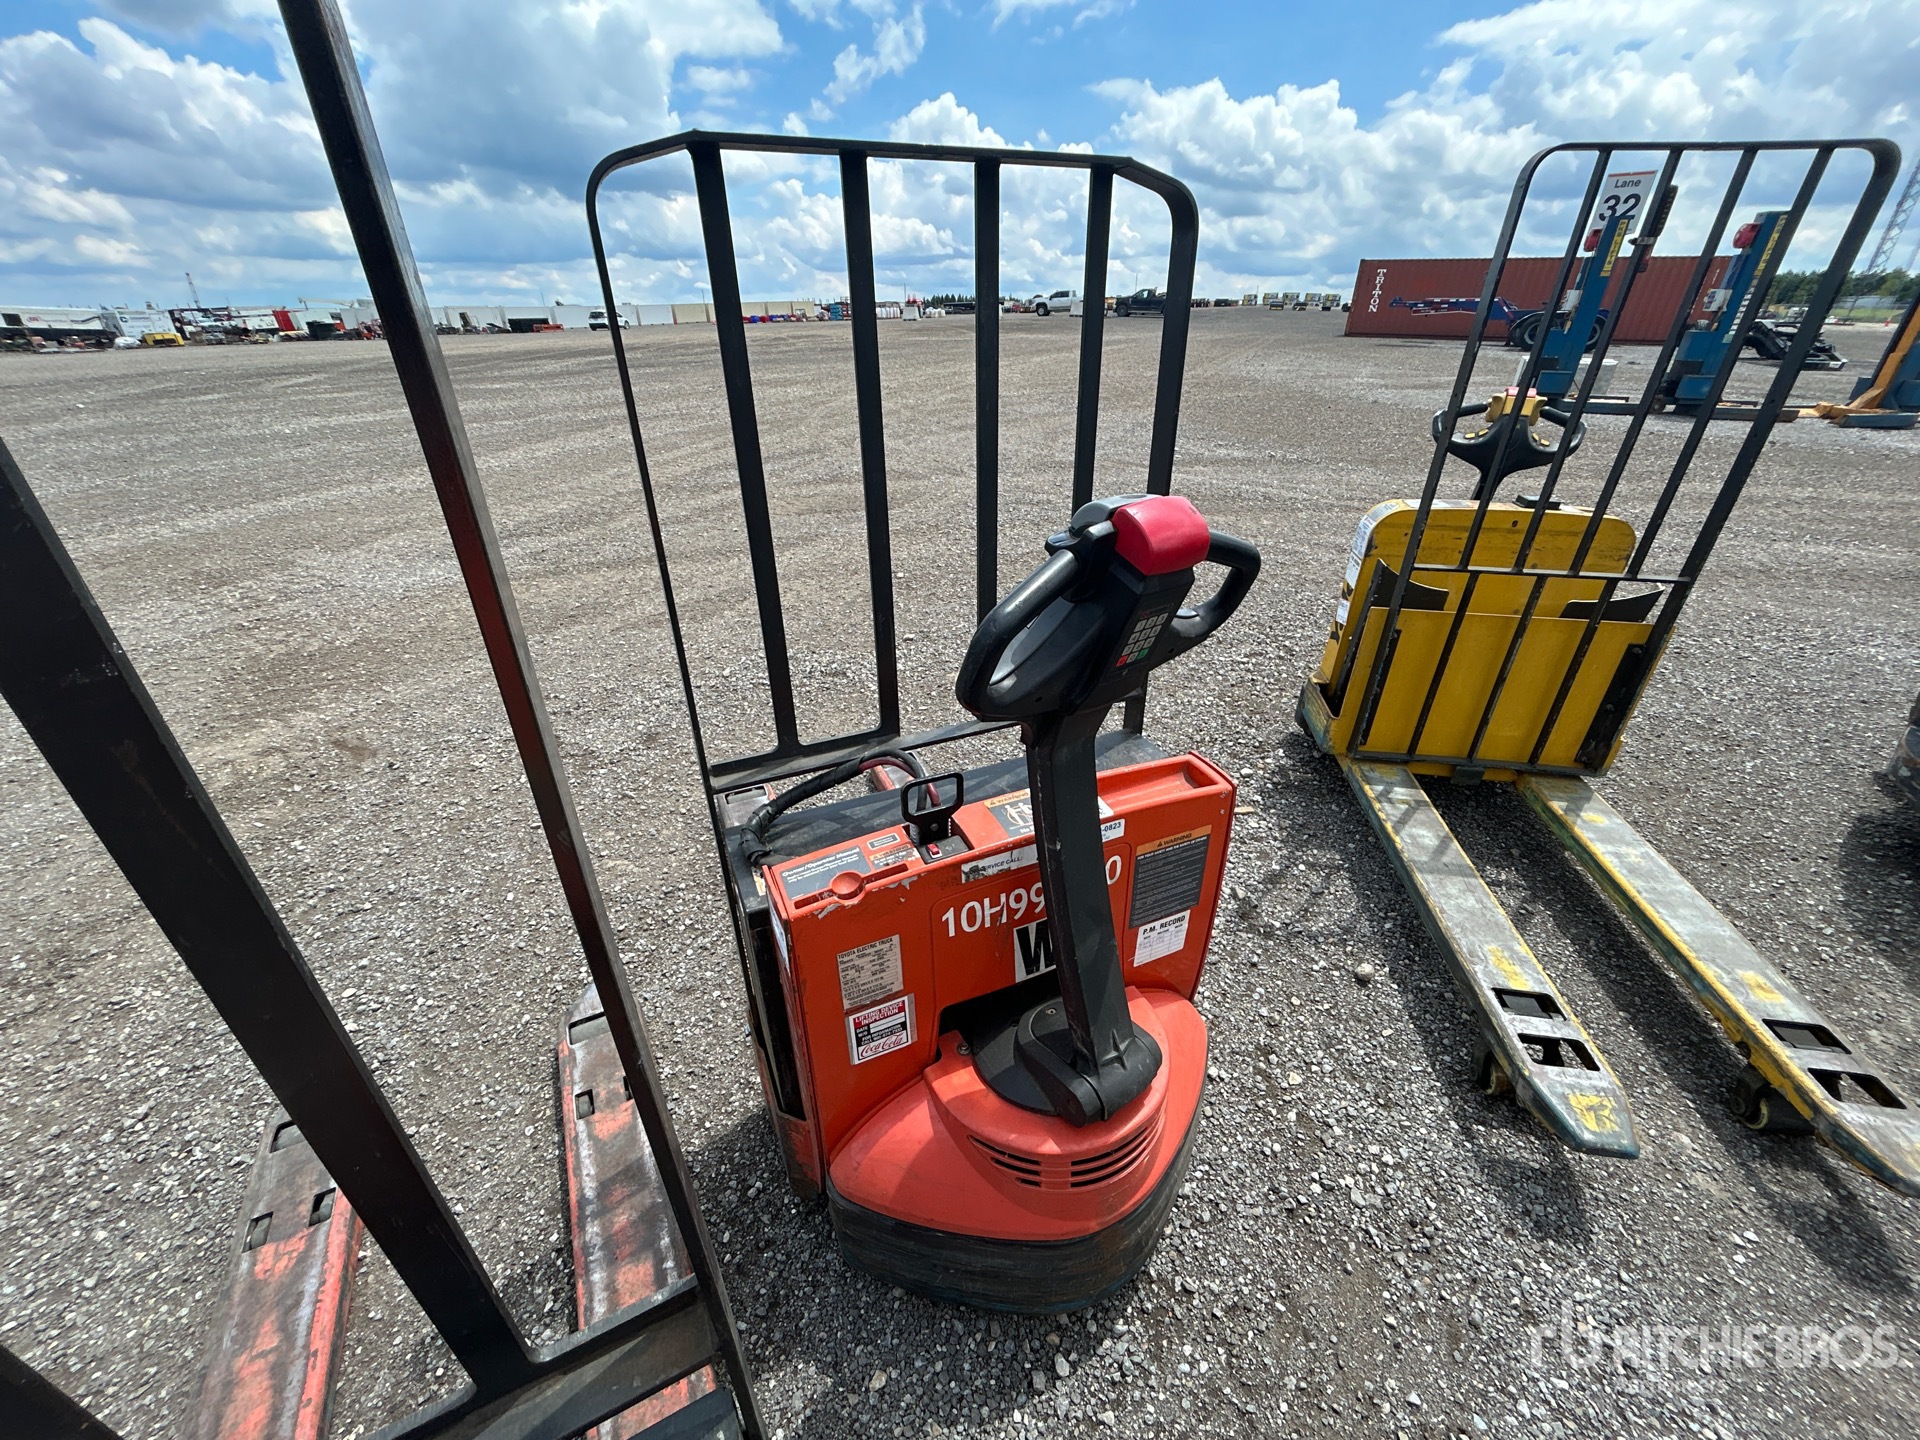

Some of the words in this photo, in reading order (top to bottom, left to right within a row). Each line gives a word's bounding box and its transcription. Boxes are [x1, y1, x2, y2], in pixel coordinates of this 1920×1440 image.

[1614, 179, 1642, 189] Lane
[1599, 193, 1642, 221] 32
[1368, 269, 1387, 313] TRITON
[1164, 833, 1192, 846] WARNING
[781, 855, 836, 877] Owner/Operator
[836, 847, 860, 860] Manual
[1006, 856, 1023, 865] CALL:
[1142, 925, 1158, 936] P.M.
[1159, 915, 1186, 929] RECORD
[838, 950, 856, 960] TOYOTA
[857, 943, 877, 954] ELECTRIC
[878, 938, 893, 946] TRUCK
[855, 1010, 880, 1023] LIFTING
[880, 1002, 903, 1014] DEVICE
[861, 1008, 899, 1026] INSPECTION
[871, 1024, 902, 1038] INFORMATION
